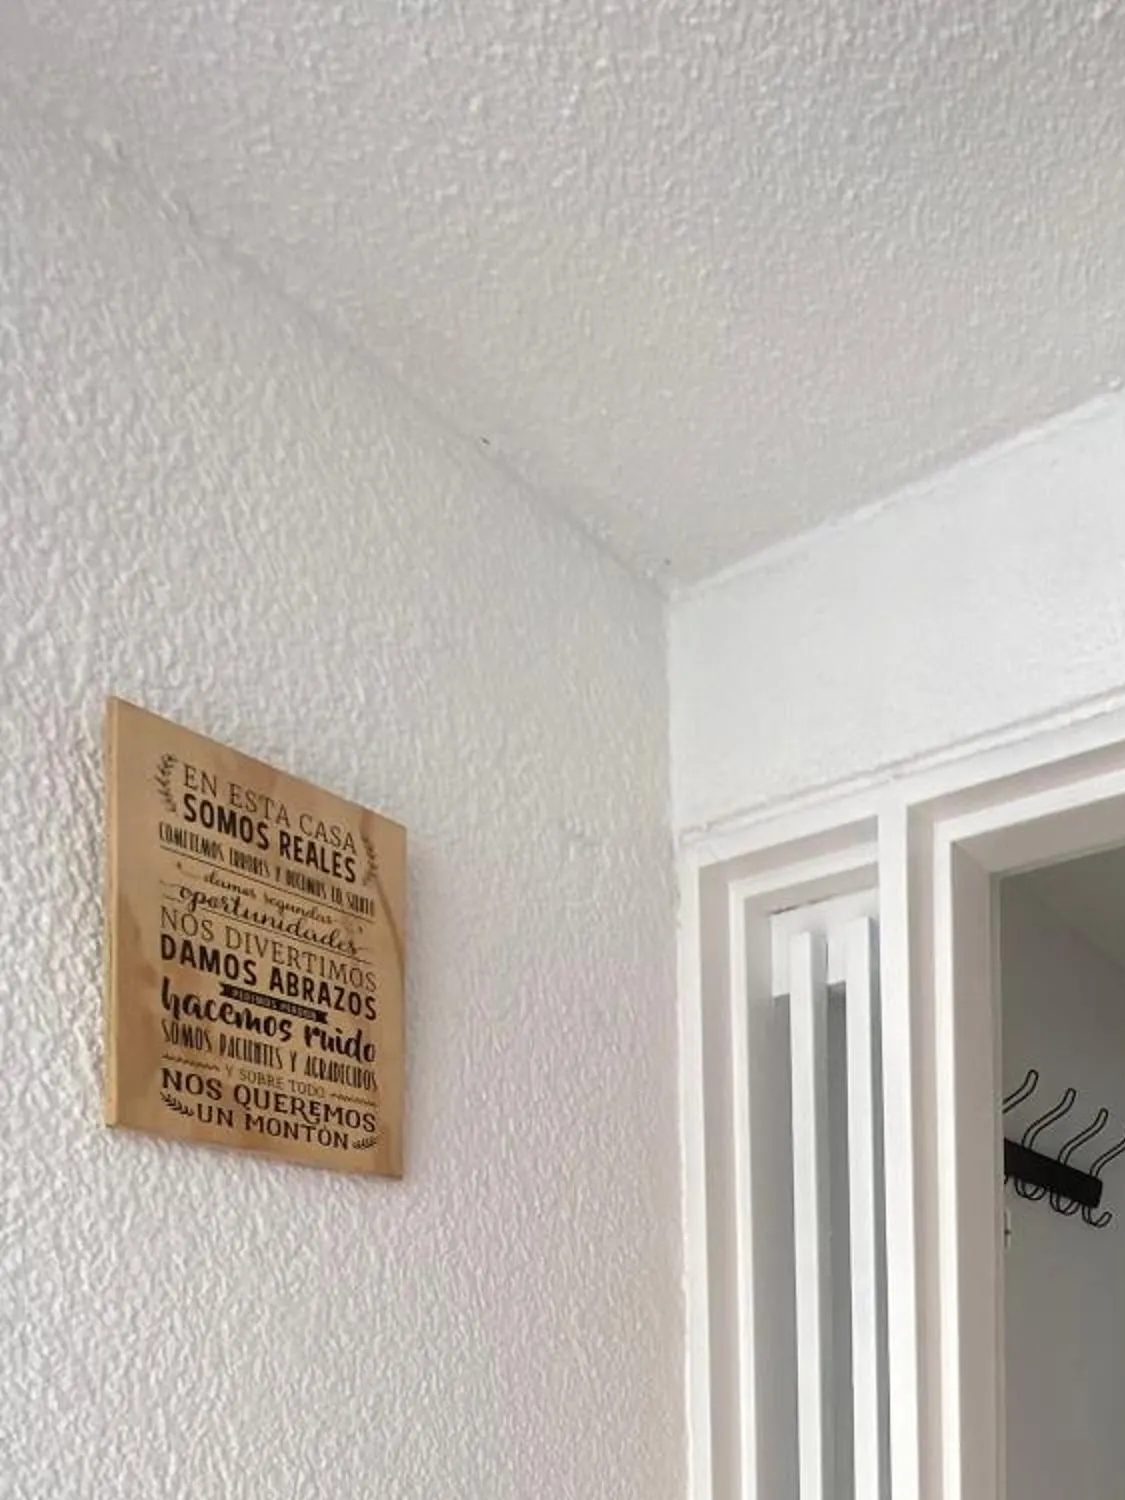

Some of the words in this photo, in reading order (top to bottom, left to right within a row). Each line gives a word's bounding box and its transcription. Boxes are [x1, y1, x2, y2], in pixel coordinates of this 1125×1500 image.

[183, 763, 217, 798] EN
[228, 782, 291, 829] ESTA
[299, 813, 357, 857] CASA
[183, 793, 270, 851] SOMOS
[279, 829, 356, 884] REALES
[160, 905, 214, 942] NOS
[225, 925, 377, 993] DIVERTIMOS
[161, 933, 257, 986] DAMOS
[269, 965, 377, 1021] ABRAZOS
[161, 976, 293, 1043] hacemos
[304, 1024, 376, 1063] ruido
[161, 1018, 212, 1053] SOMOS
[220, 1032, 283, 1070] PACIENTES
[289, 1048, 297, 1073] Y
[303, 1054, 378, 1093] AGRADECIDOS
[162, 1067, 223, 1101] NOS
[233, 1083, 376, 1133] QUEREMOS
[197, 1103, 234, 1129] UN
[225, 1063, 234, 1078] Y
[239, 1067, 285, 1091] SOBRE
[287, 1079, 325, 1099] TODO
